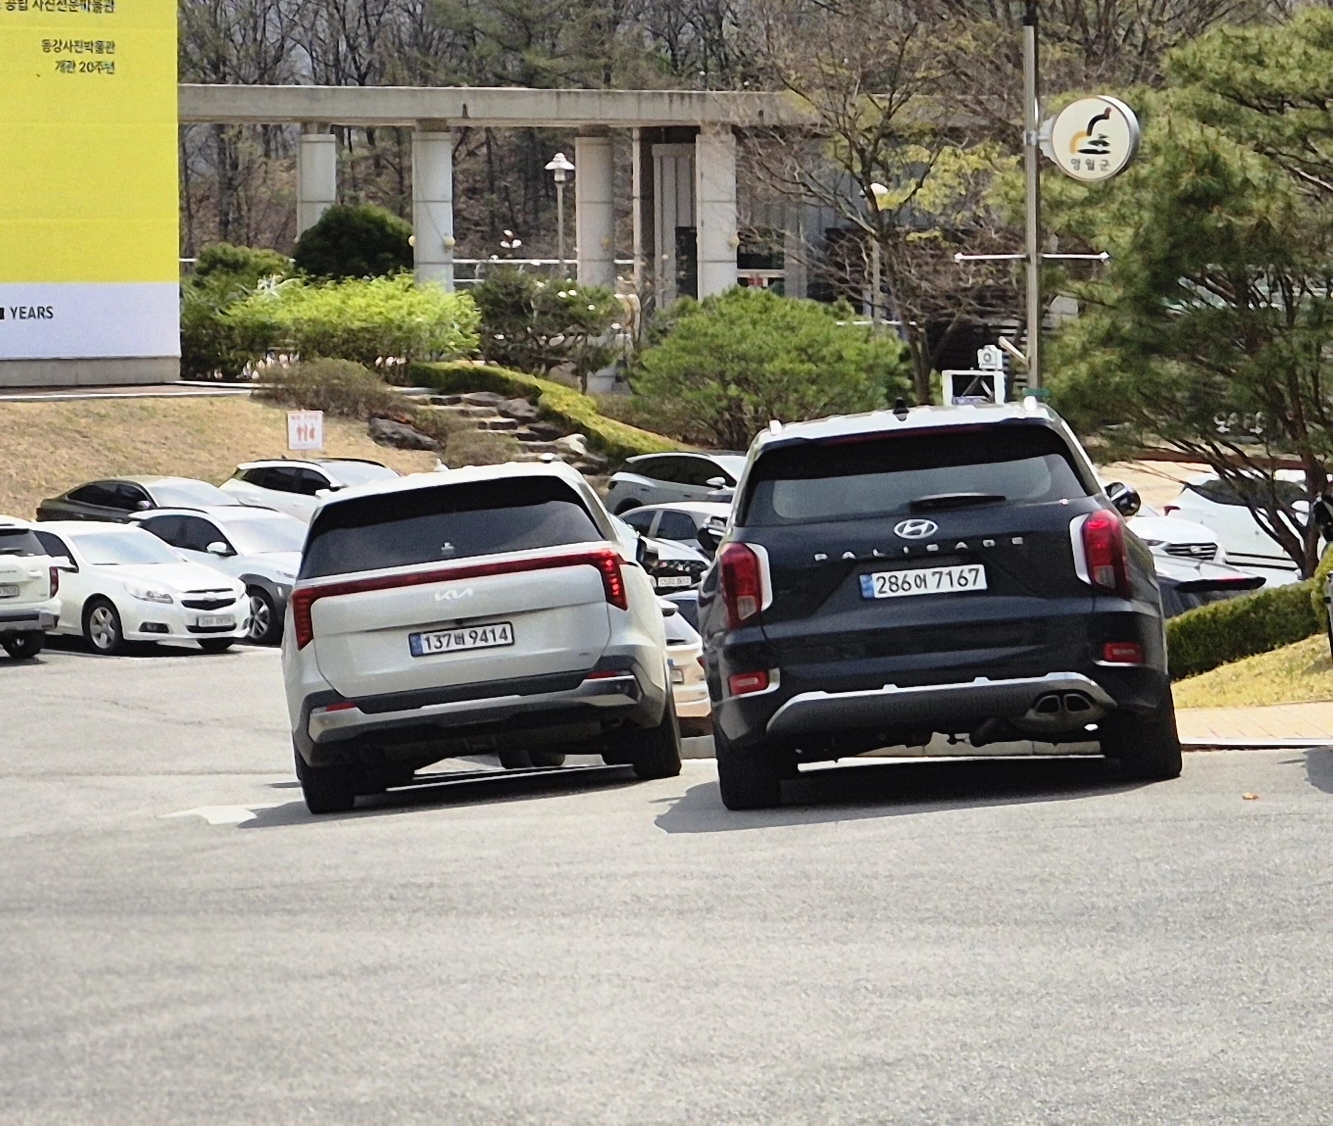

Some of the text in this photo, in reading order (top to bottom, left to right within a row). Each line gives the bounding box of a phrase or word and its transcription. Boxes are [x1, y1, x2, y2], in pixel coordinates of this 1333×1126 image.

[41, 39, 116, 55] 동강사진박물관
[78, 60, 116, 75] 20주년
[1070, 158, 1111, 172] 영월군
[9, 305, 54, 320] YEARS
[814, 536, 1024, 562] PALISADE
[875, 567, 981, 595] 286어 7167
[468, 626, 509, 645] 9414
